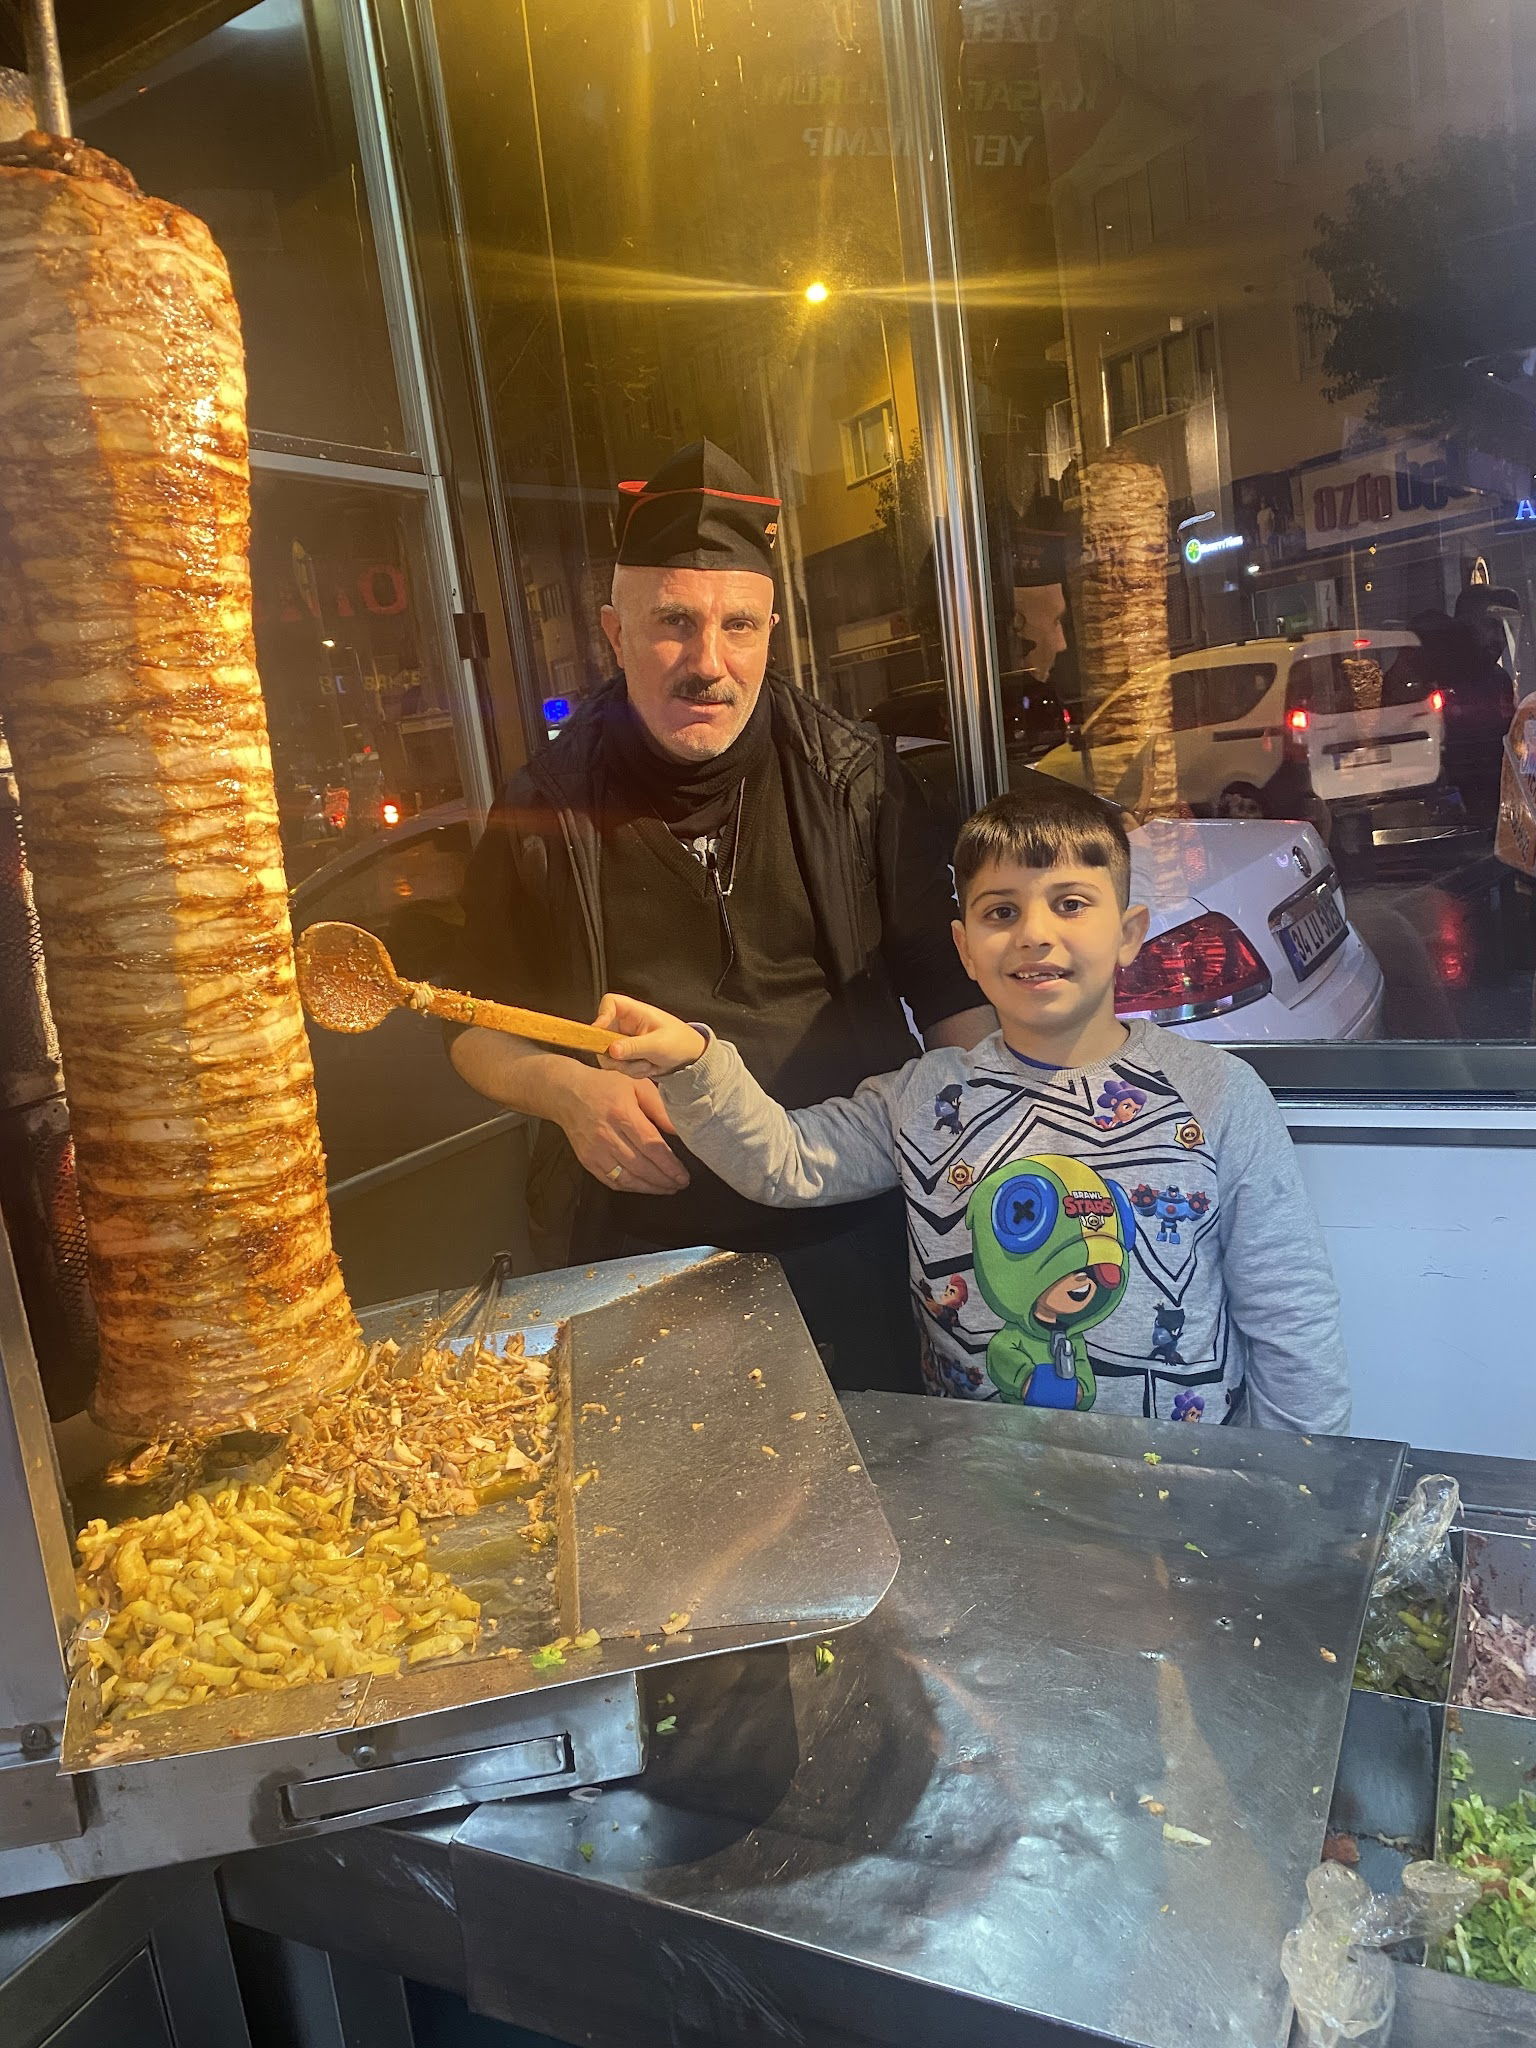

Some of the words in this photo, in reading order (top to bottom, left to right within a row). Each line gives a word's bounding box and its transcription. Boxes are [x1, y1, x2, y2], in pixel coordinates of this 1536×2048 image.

[1291, 925, 1312, 961] 34
[1071, 1191, 1103, 1200] BRAWL
[1063, 1196, 1115, 1217] STARS
